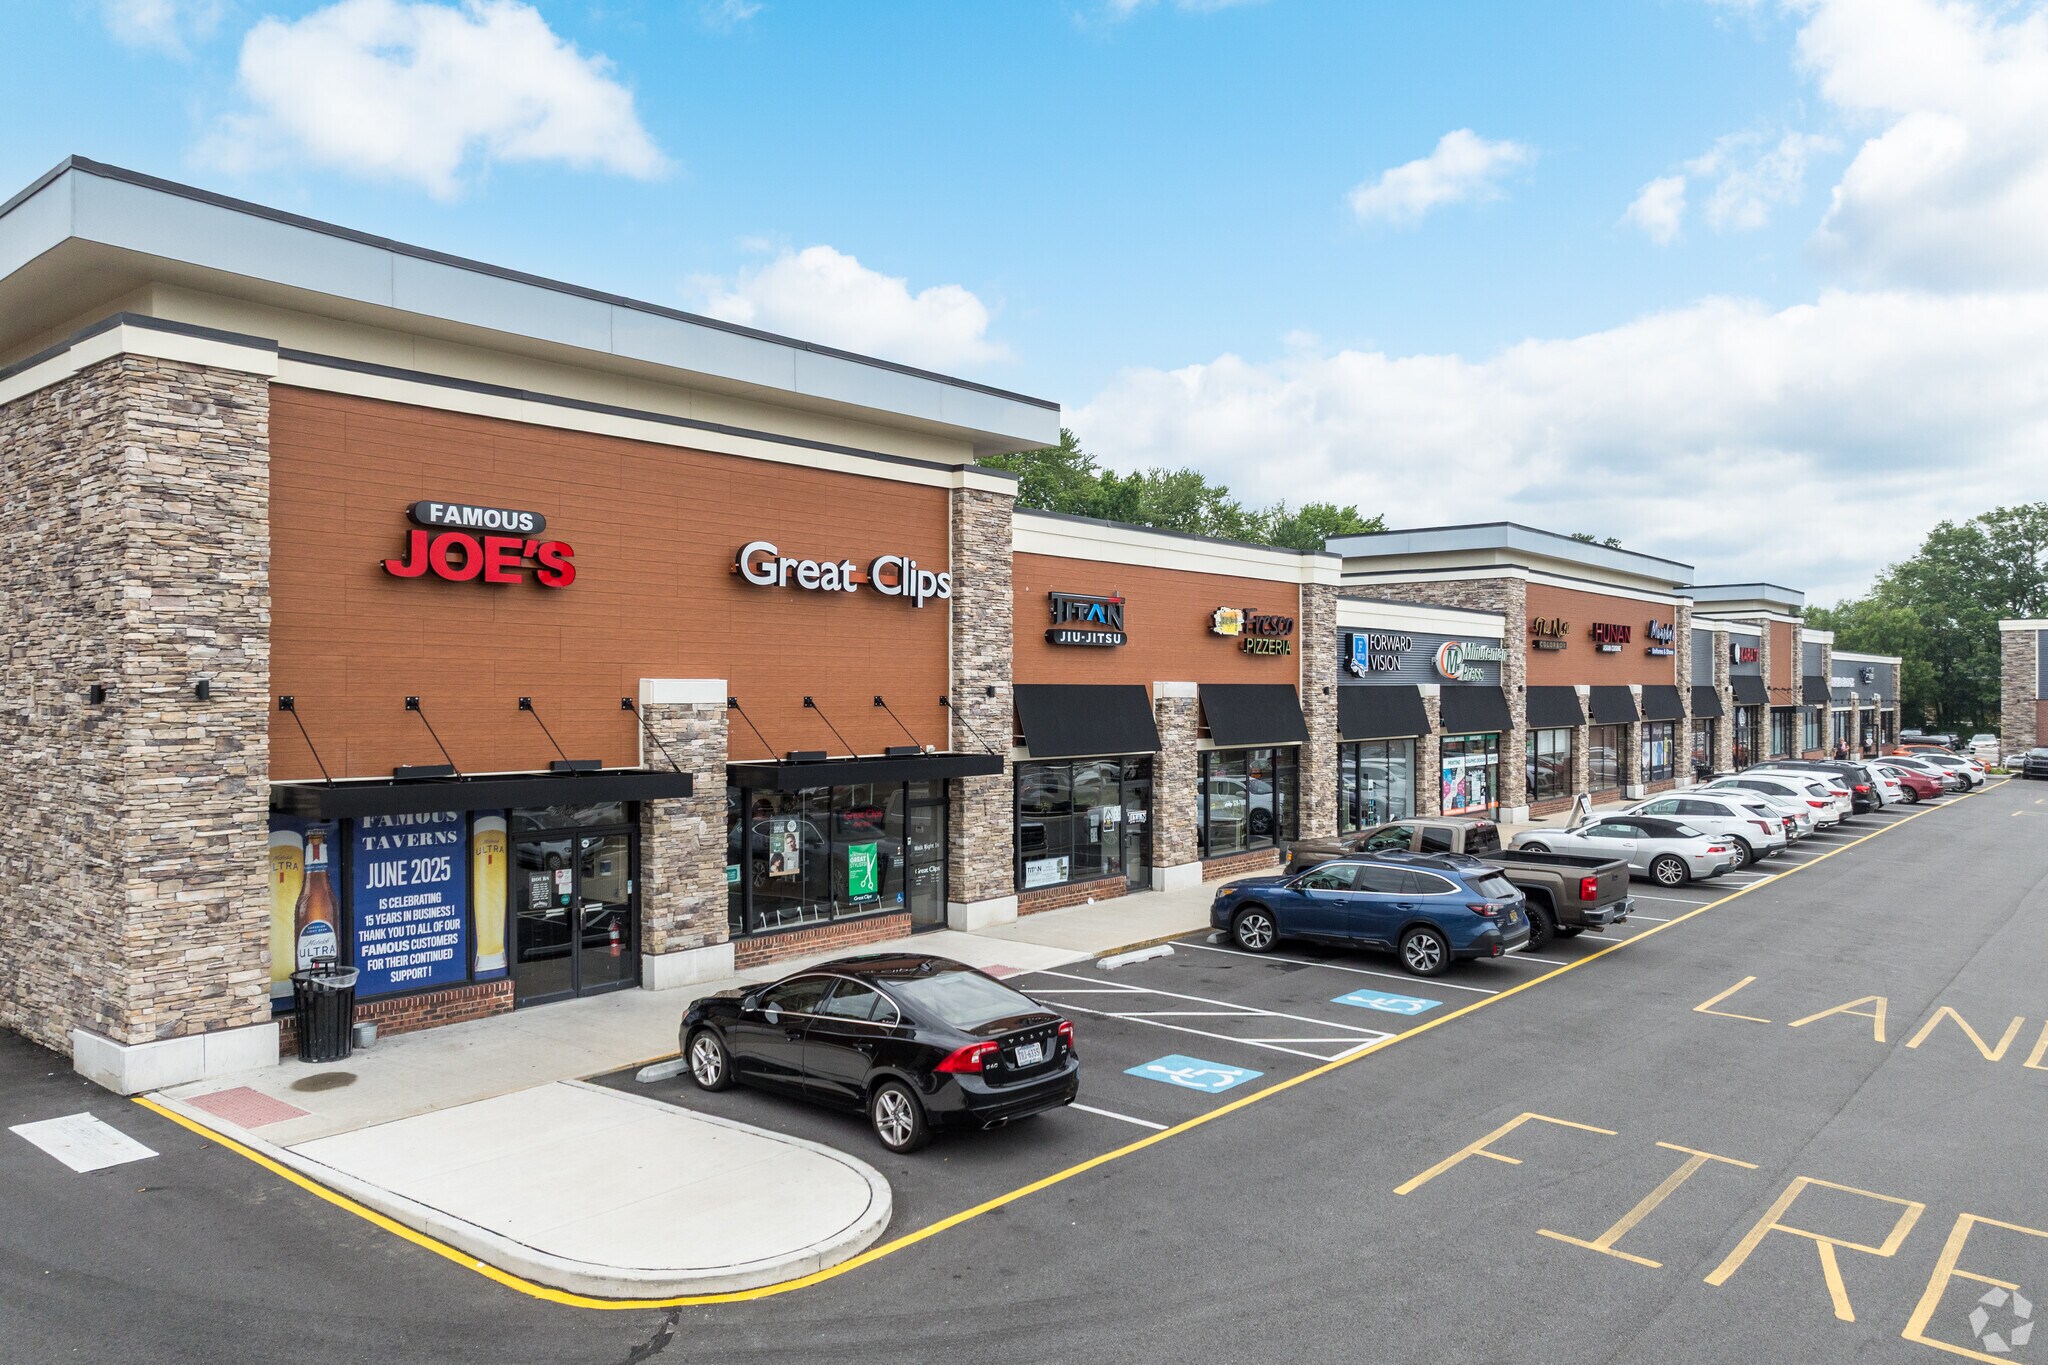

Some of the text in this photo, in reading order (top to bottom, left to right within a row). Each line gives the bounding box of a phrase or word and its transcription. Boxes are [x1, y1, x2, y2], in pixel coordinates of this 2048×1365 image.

[430, 503, 533, 531] FAMOUS
[384, 529, 577, 588] JOE'S
[740, 541, 950, 608] Great Clips
[1051, 592, 1125, 631] TITAN
[1243, 608, 1294, 635] Fresco
[1060, 631, 1121, 644] JIU-JITSU
[1370, 634, 1413, 651] FORWARD
[1595, 624, 1631, 643] HUNAN
[1246, 638, 1291, 655] PIZZERIA
[1463, 643, 1508, 661] Minuteman
[1370, 655, 1401, 670] VISION
[1460, 664, 1484, 681] Press
[362, 811, 458, 829] FAMOUS
[362, 830, 458, 851] TAVERNS
[475, 844, 504, 856] ULTRA
[271, 861, 299, 871] LTRA
[366, 856, 451, 889] JUNE 2025
[379, 892, 442, 910] IS CELEBRATING
[364, 914, 374, 926] 15
[375, 911, 402, 925] YEARS
[403, 909, 412, 922] IN
[413, 905, 451, 920] BUSINESS
[358, 918, 461, 942] THANK YOU TO ALL OF OUR
[300, 945, 336, 958] ULTRA
[361, 933, 458, 957] FAMOUS CUSTOMERS
[367, 948, 453, 971] FOR THEIR CONTINUED
[390, 966, 428, 983] SUPPORT
[1008, 1029, 1052, 1044] VOLVO
[985, 1062, 998, 1070] S60
[1393, 1112, 2048, 1365] FIRE
